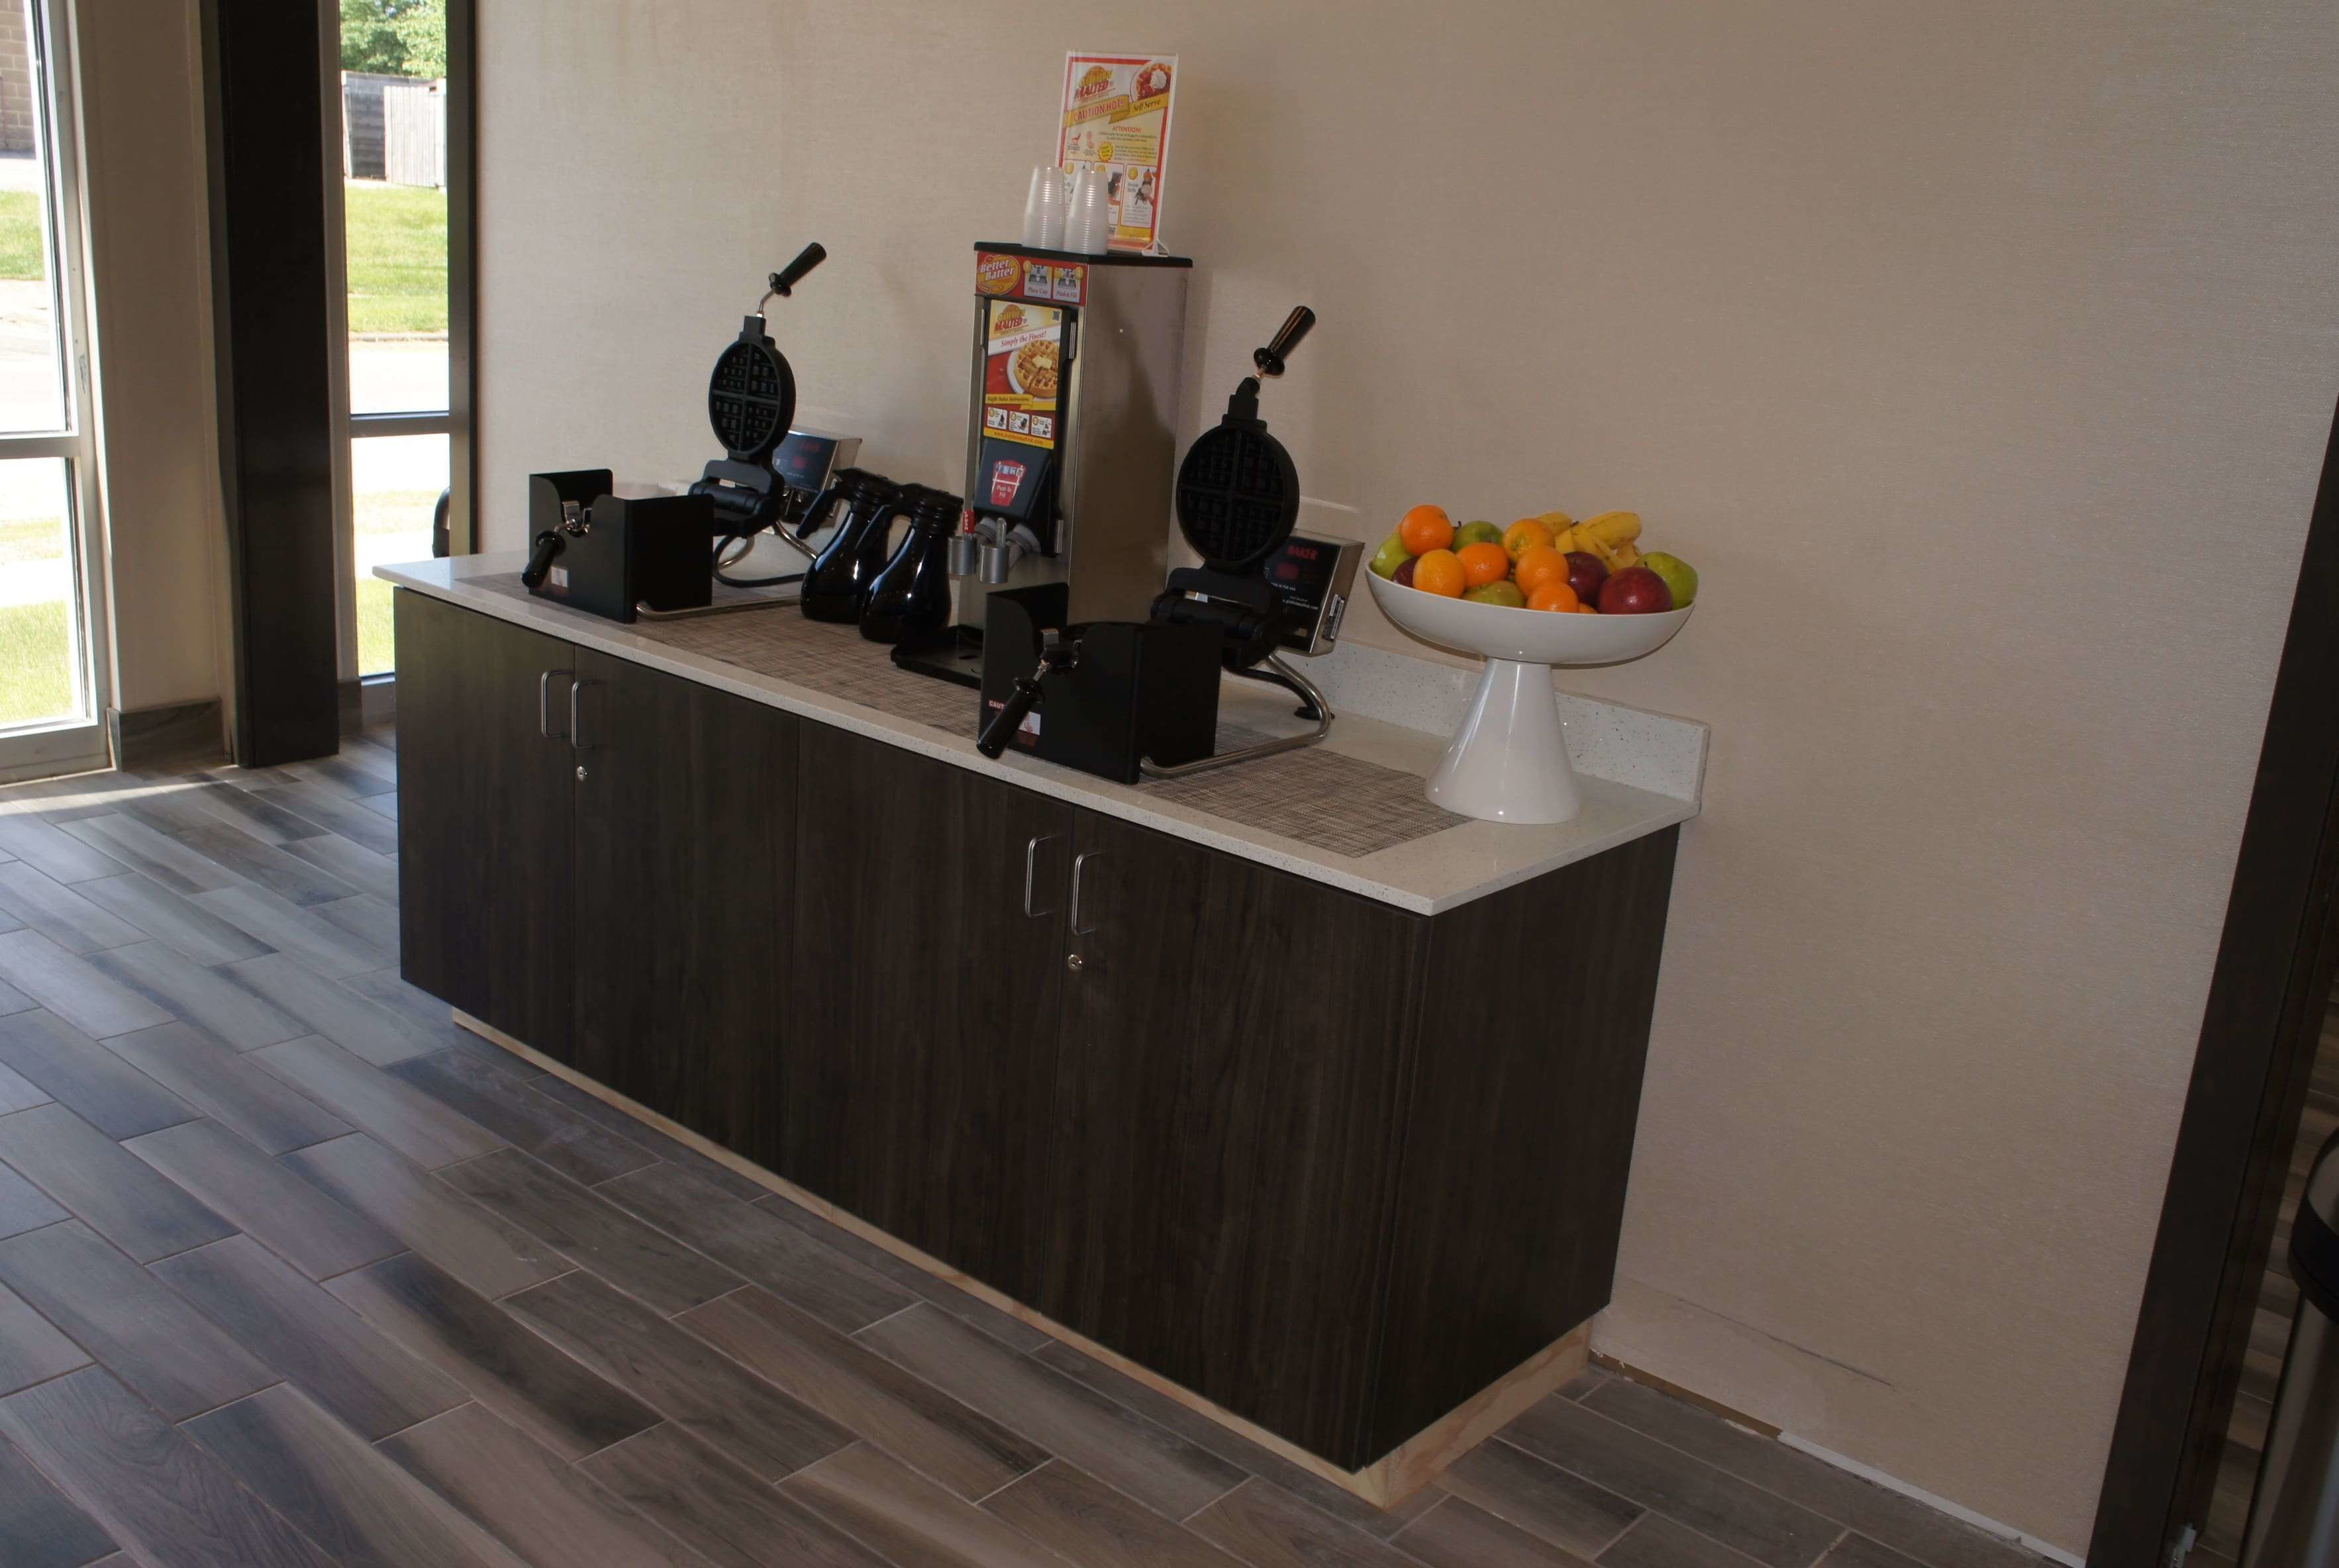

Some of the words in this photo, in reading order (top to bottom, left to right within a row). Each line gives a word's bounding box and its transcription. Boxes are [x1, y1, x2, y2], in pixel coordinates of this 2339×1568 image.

[1075, 79, 1110, 99] MALTED
[1073, 103, 1105, 122] CAUTION
[1106, 99, 1124, 112] HOT!
[980, 260, 1009, 273] Better
[985, 268, 1015, 281] Batter
[1001, 337, 1019, 347] Simply
[1019, 334, 1028, 342] the
[1028, 330, 1047, 340] Finest!
